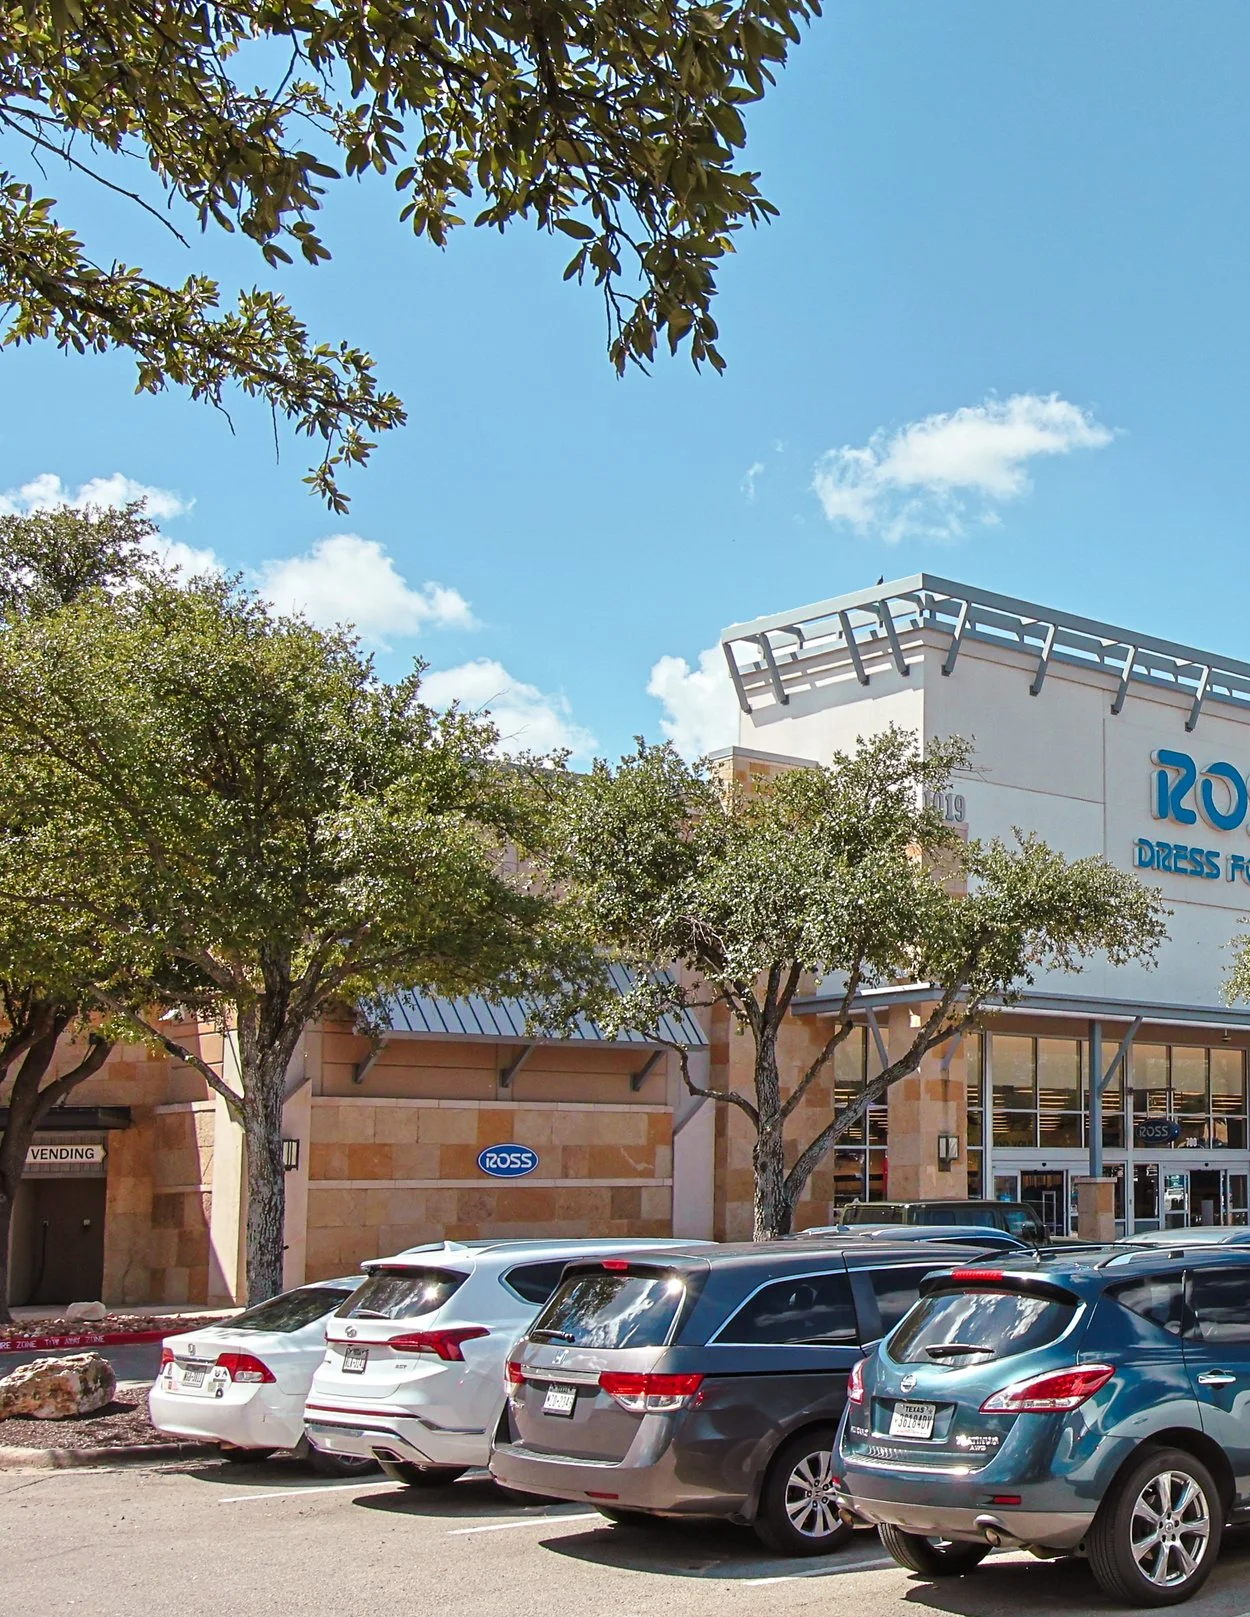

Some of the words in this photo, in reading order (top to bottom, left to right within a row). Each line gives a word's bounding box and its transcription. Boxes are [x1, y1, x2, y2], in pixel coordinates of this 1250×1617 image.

[1133, 837, 1220, 879] DRESS
[1139, 1125, 1169, 1137] ROSS
[31, 1148, 95, 1160] VENDING
[486, 1152, 533, 1168] ROSS
[16, 1340, 37, 1349] ZONE
[85, 1335, 105, 1343] ZONE
[905, 1405, 925, 1413] TEXAS
